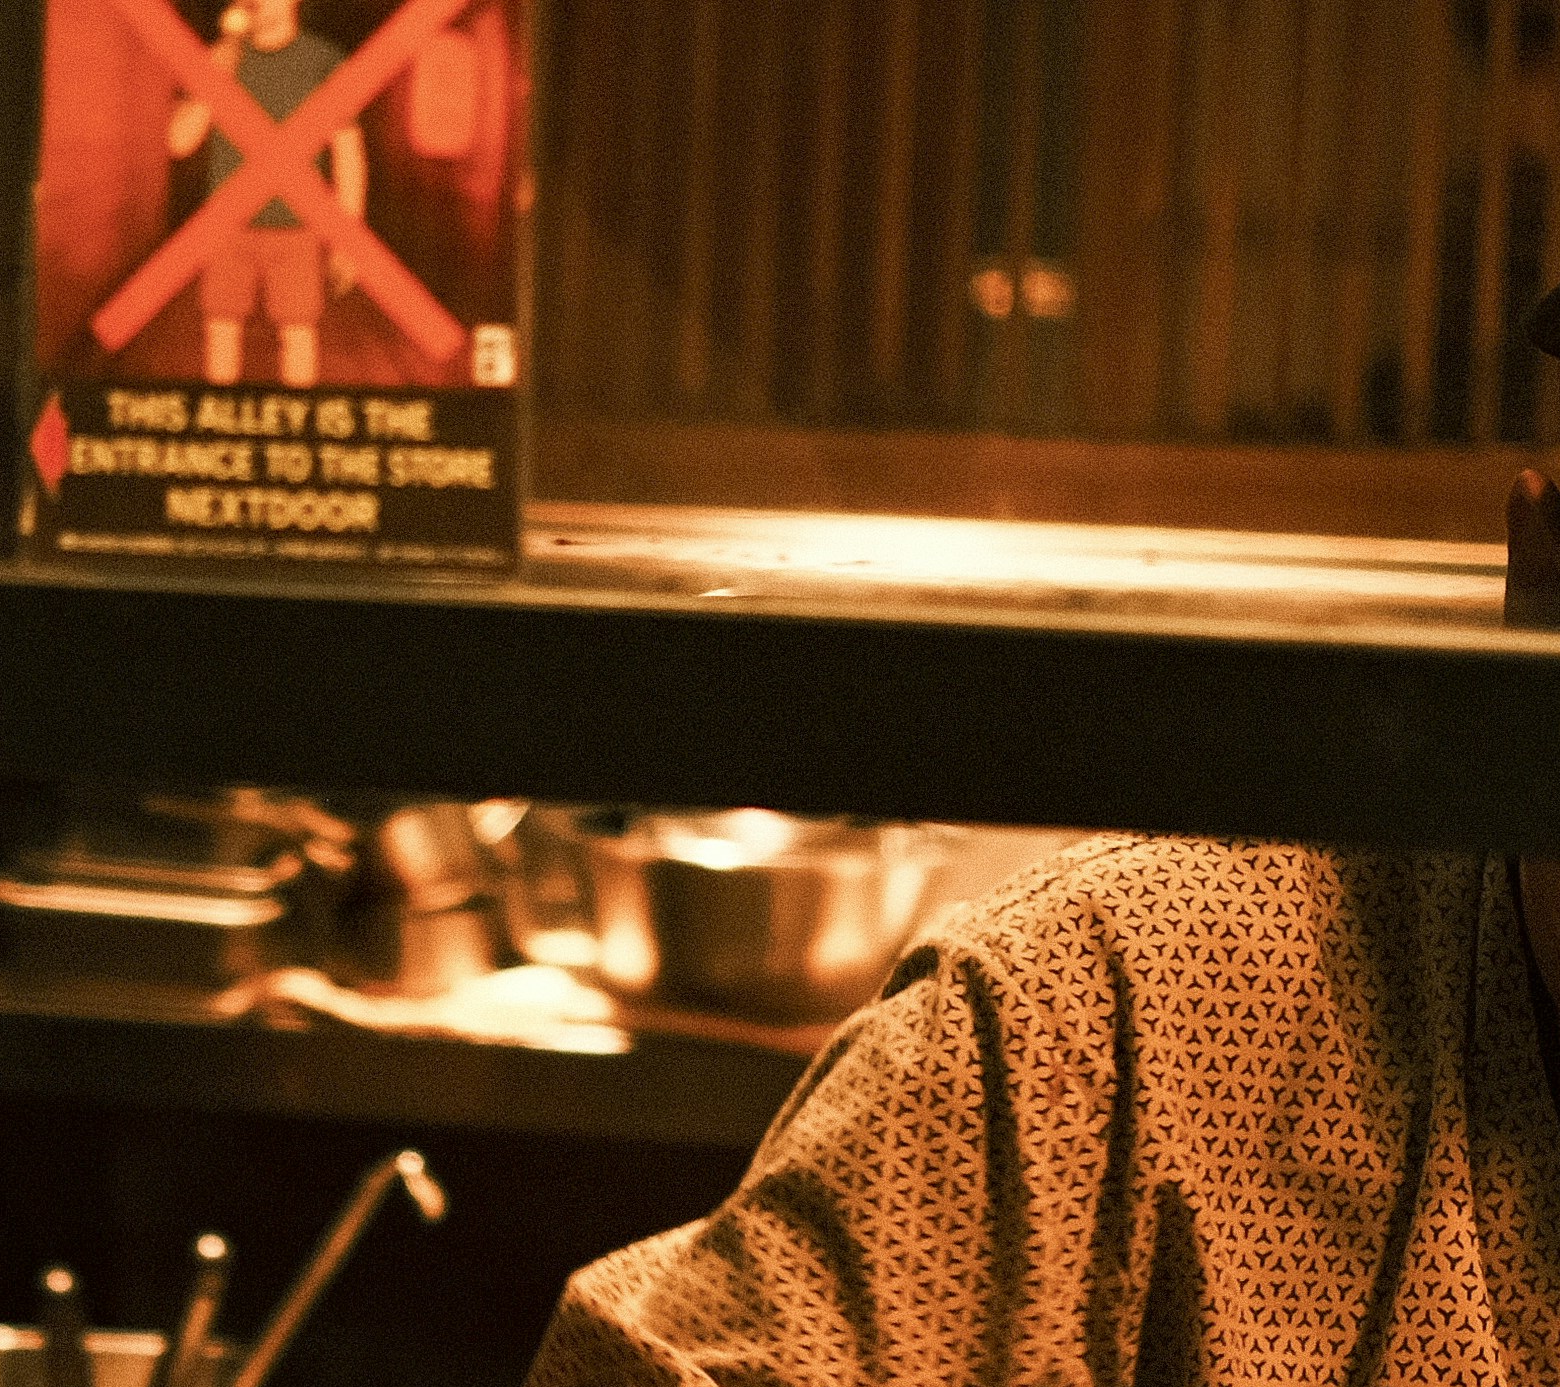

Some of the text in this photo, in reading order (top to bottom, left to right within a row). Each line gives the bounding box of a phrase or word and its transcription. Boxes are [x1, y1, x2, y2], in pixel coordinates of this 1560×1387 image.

[108, 393, 432, 441] THIS ALLEY IS THE
[69, 437, 493, 488] ENTRANCE TO THE STORE
[164, 488, 379, 531] NEXTDOOR
